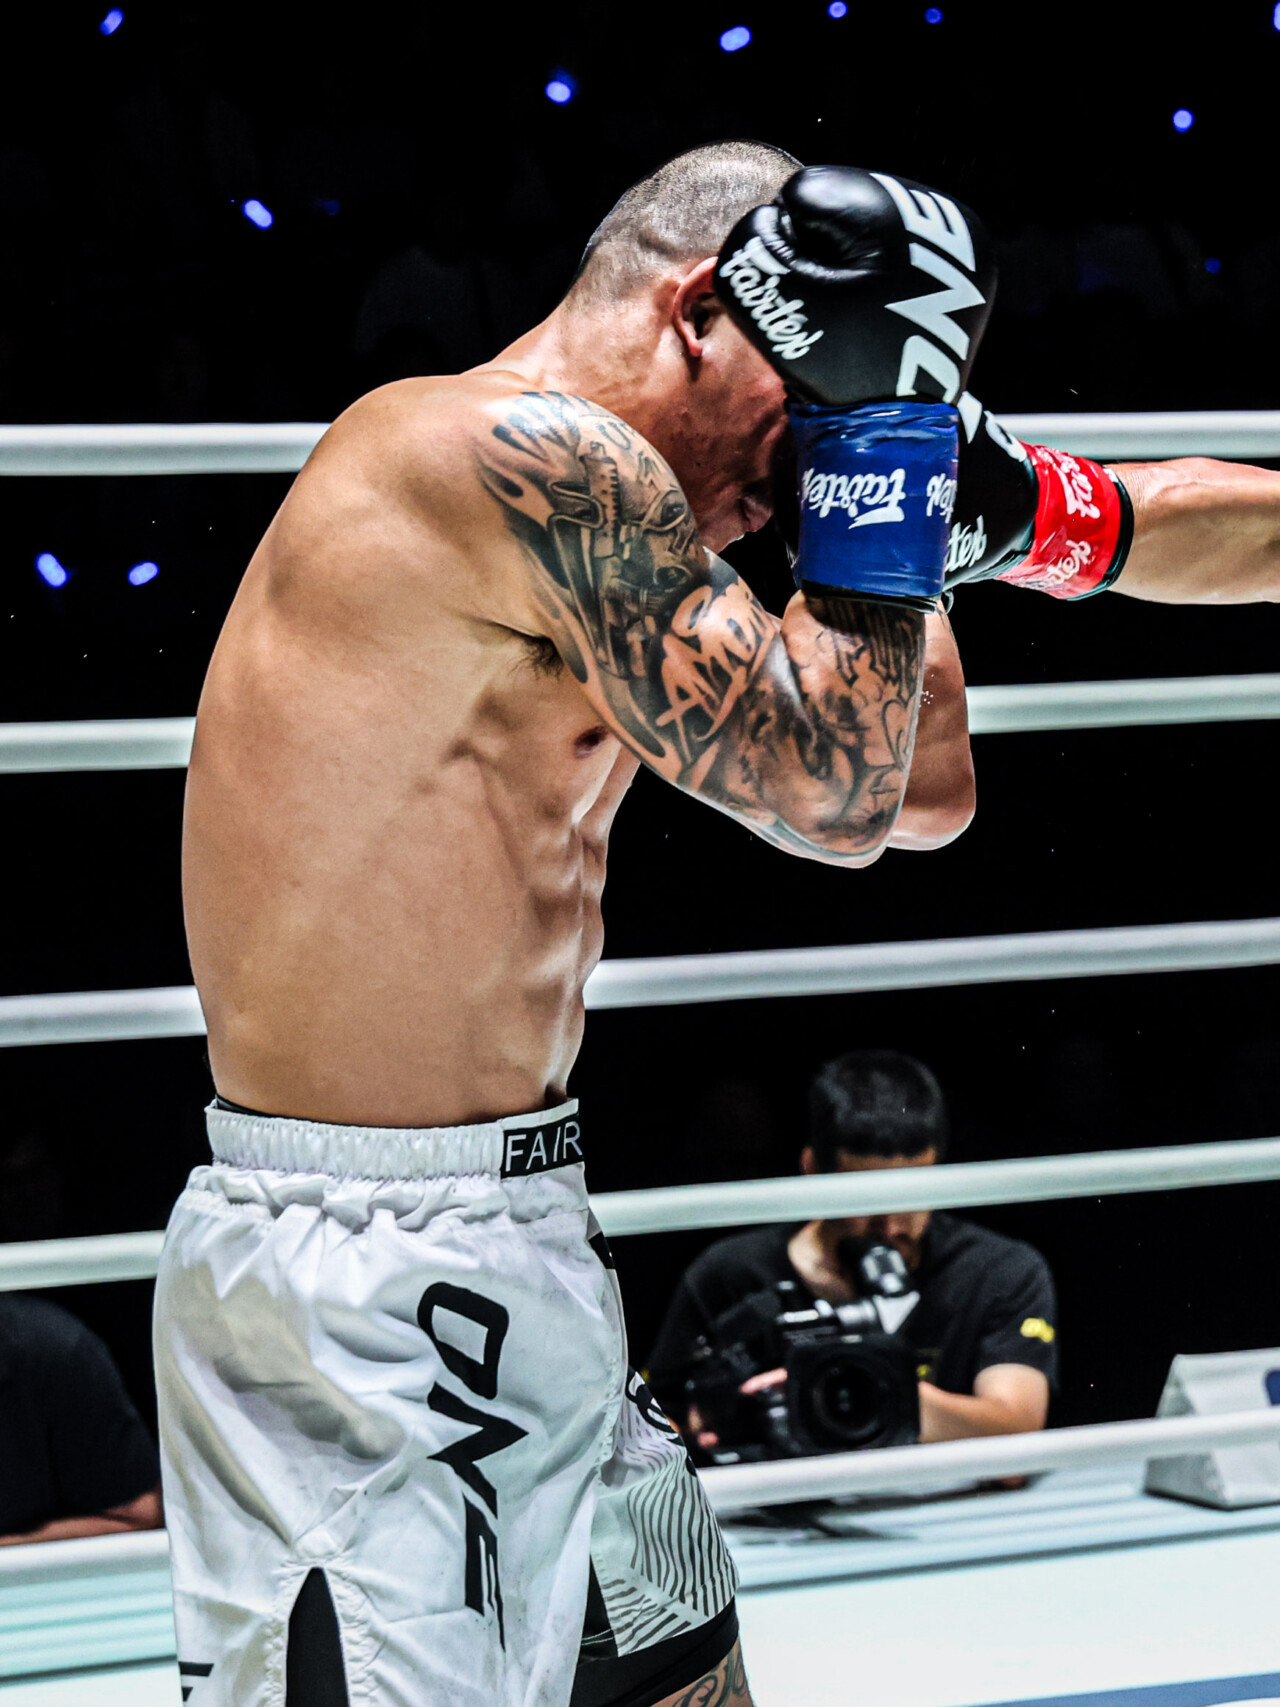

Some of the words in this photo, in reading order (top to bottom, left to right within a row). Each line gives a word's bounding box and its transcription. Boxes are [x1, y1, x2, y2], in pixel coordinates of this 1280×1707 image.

[719, 236, 824, 361] Fairtex
[869, 172, 986, 404] ONE
[505, 1121, 583, 1172] FAIR
[418, 1281, 529, 1652] ONE
